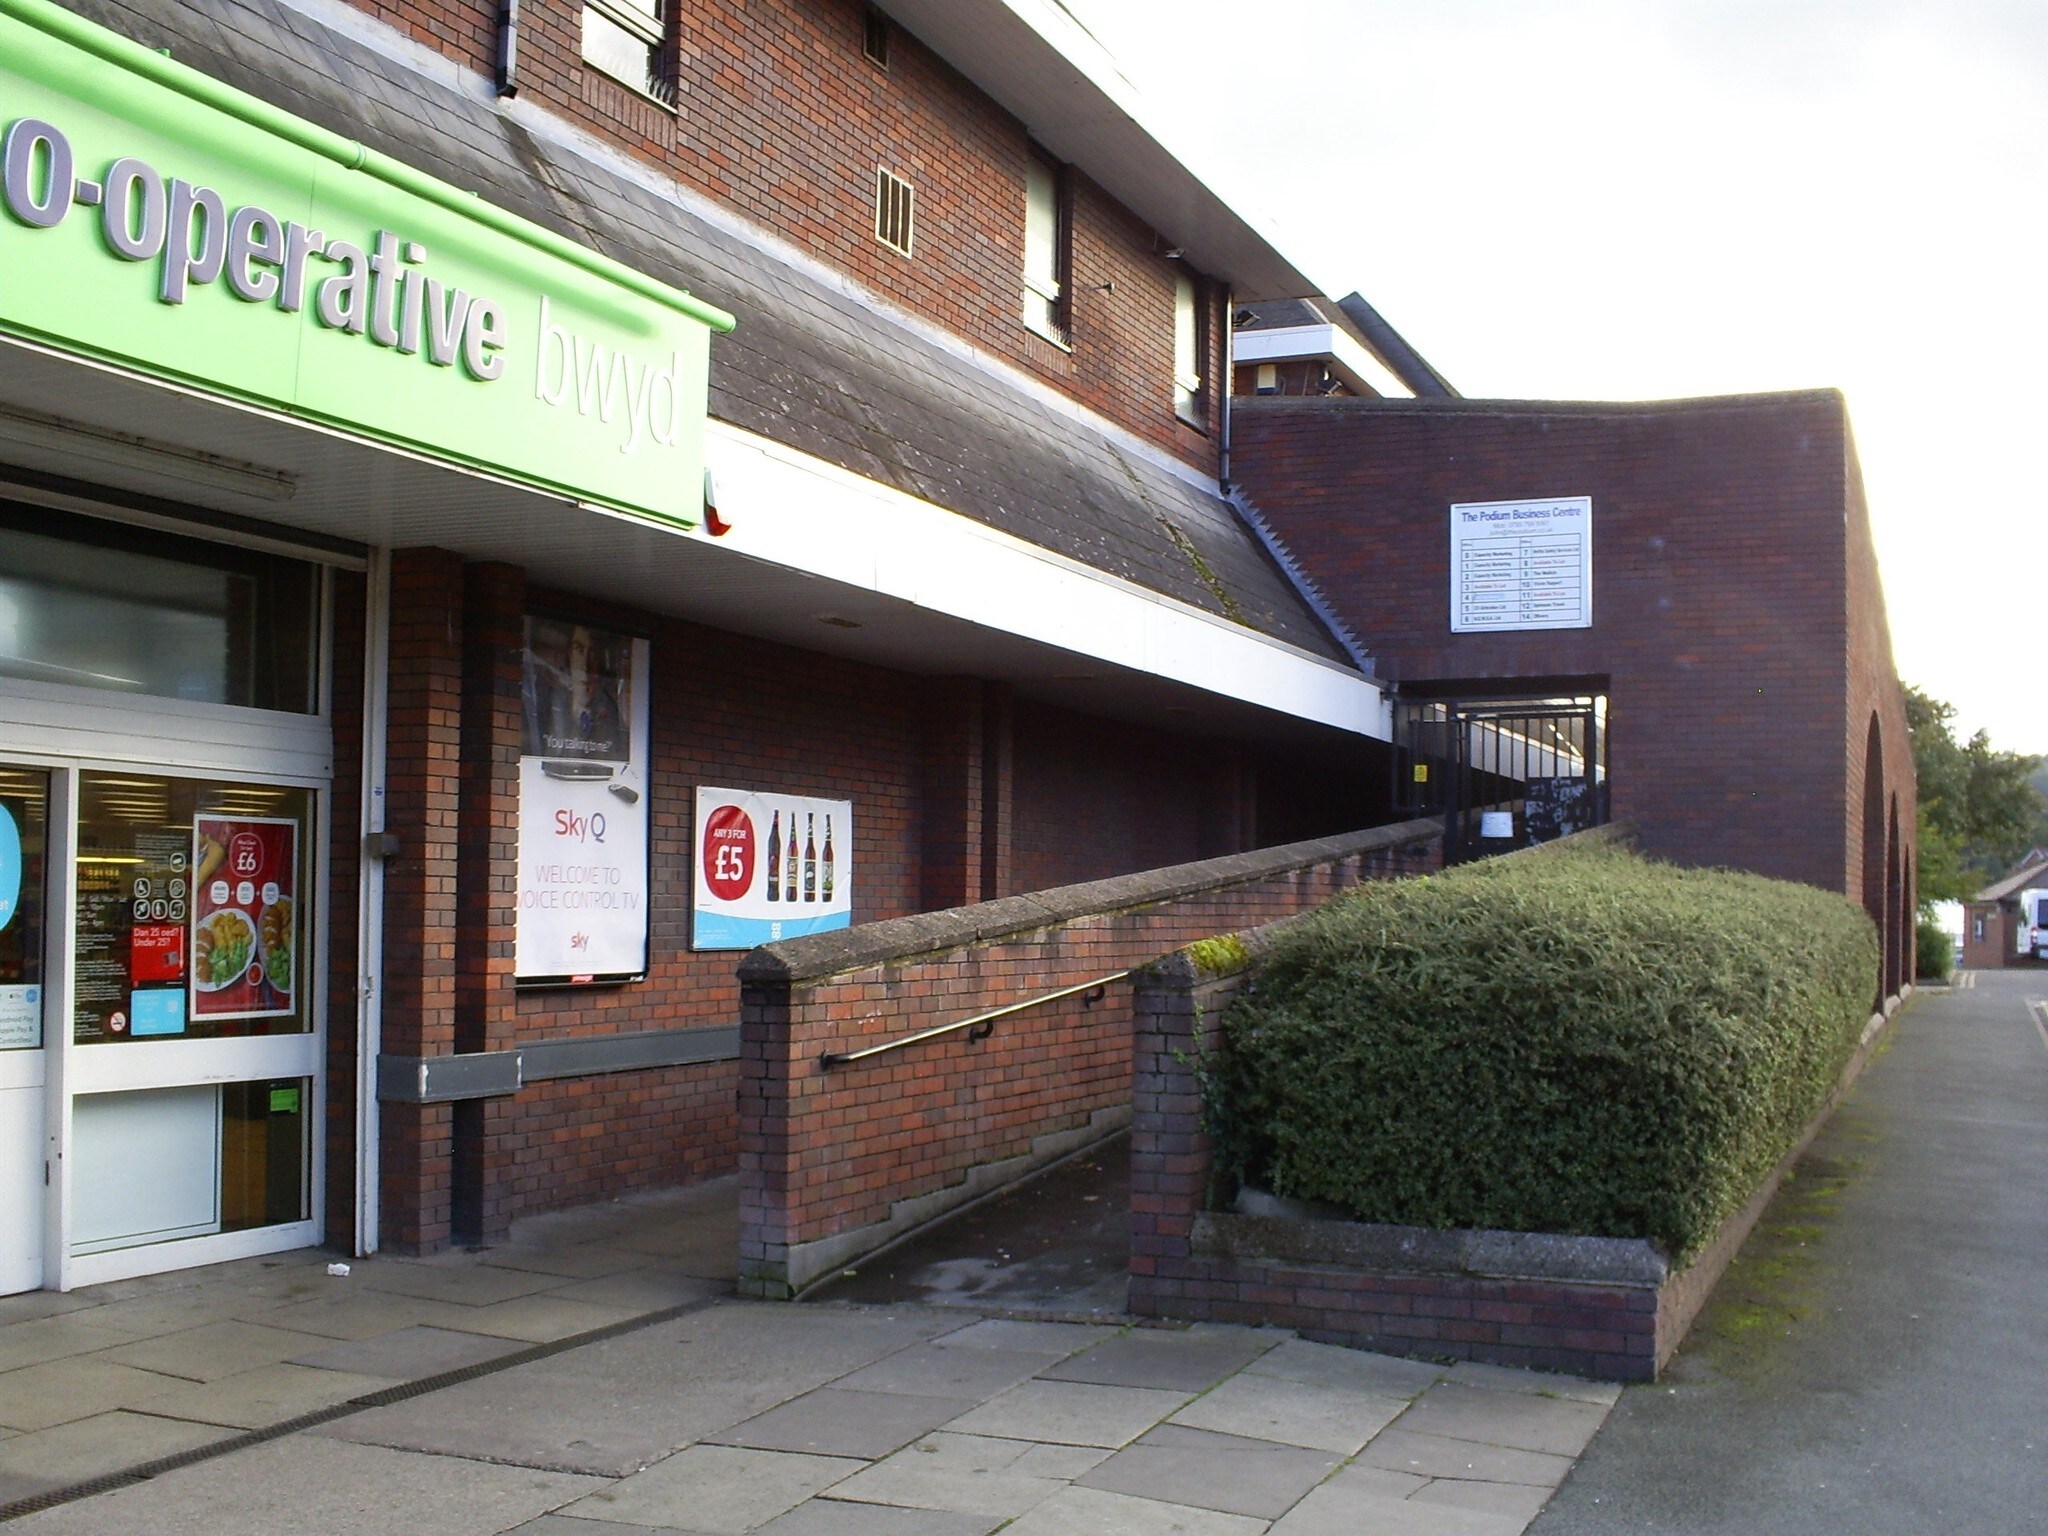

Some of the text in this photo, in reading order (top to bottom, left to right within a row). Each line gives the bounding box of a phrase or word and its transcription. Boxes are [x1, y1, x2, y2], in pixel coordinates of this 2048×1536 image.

[534, 294, 684, 454] bwyd
[1461, 506, 1581, 522] The Podium Business Centre
[555, 809, 606, 843] Sky Q
[713, 828, 747, 839] ANY 3 FOR
[236, 851, 257, 871] £6
[714, 844, 744, 882] £5
[535, 865, 620, 885] WELCOME TO
[563, 890, 619, 909] CONTROL
[621, 892, 639, 909] TV
[133, 938, 171, 946] Under 25?
[150, 928, 159, 936] 25
[571, 931, 589, 952] sky
